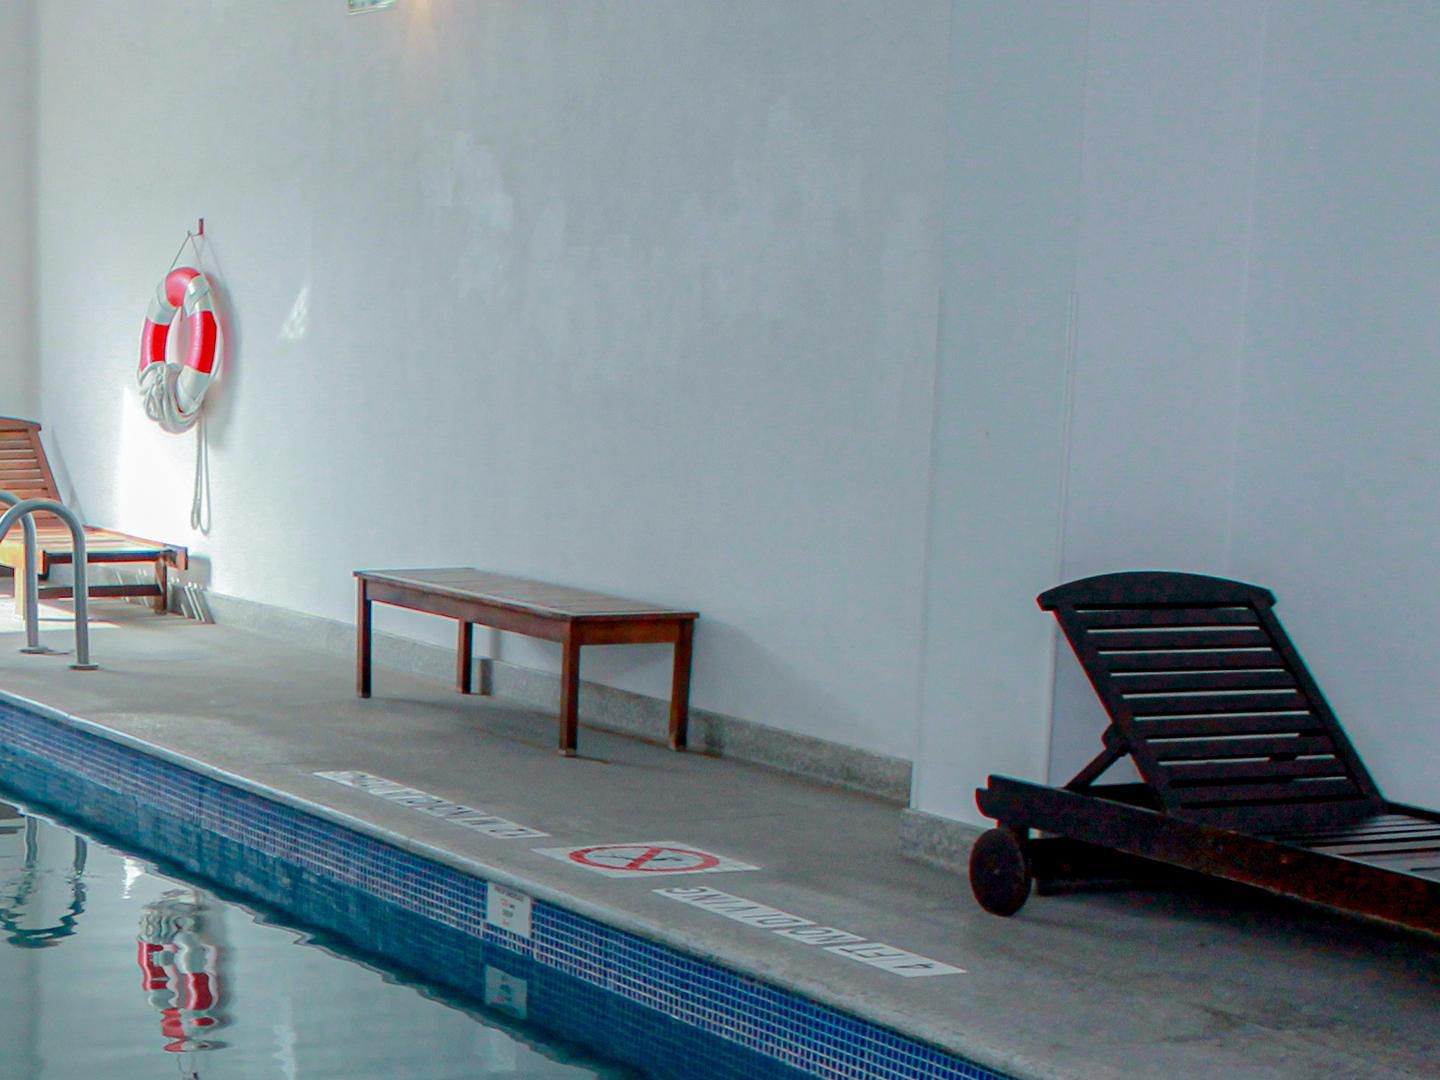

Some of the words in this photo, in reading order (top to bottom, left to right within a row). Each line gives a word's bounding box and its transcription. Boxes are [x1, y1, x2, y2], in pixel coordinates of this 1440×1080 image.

[665, 887, 800, 926] DIVING
[789, 927, 860, 944] NO
[838, 946, 904, 960] FT
